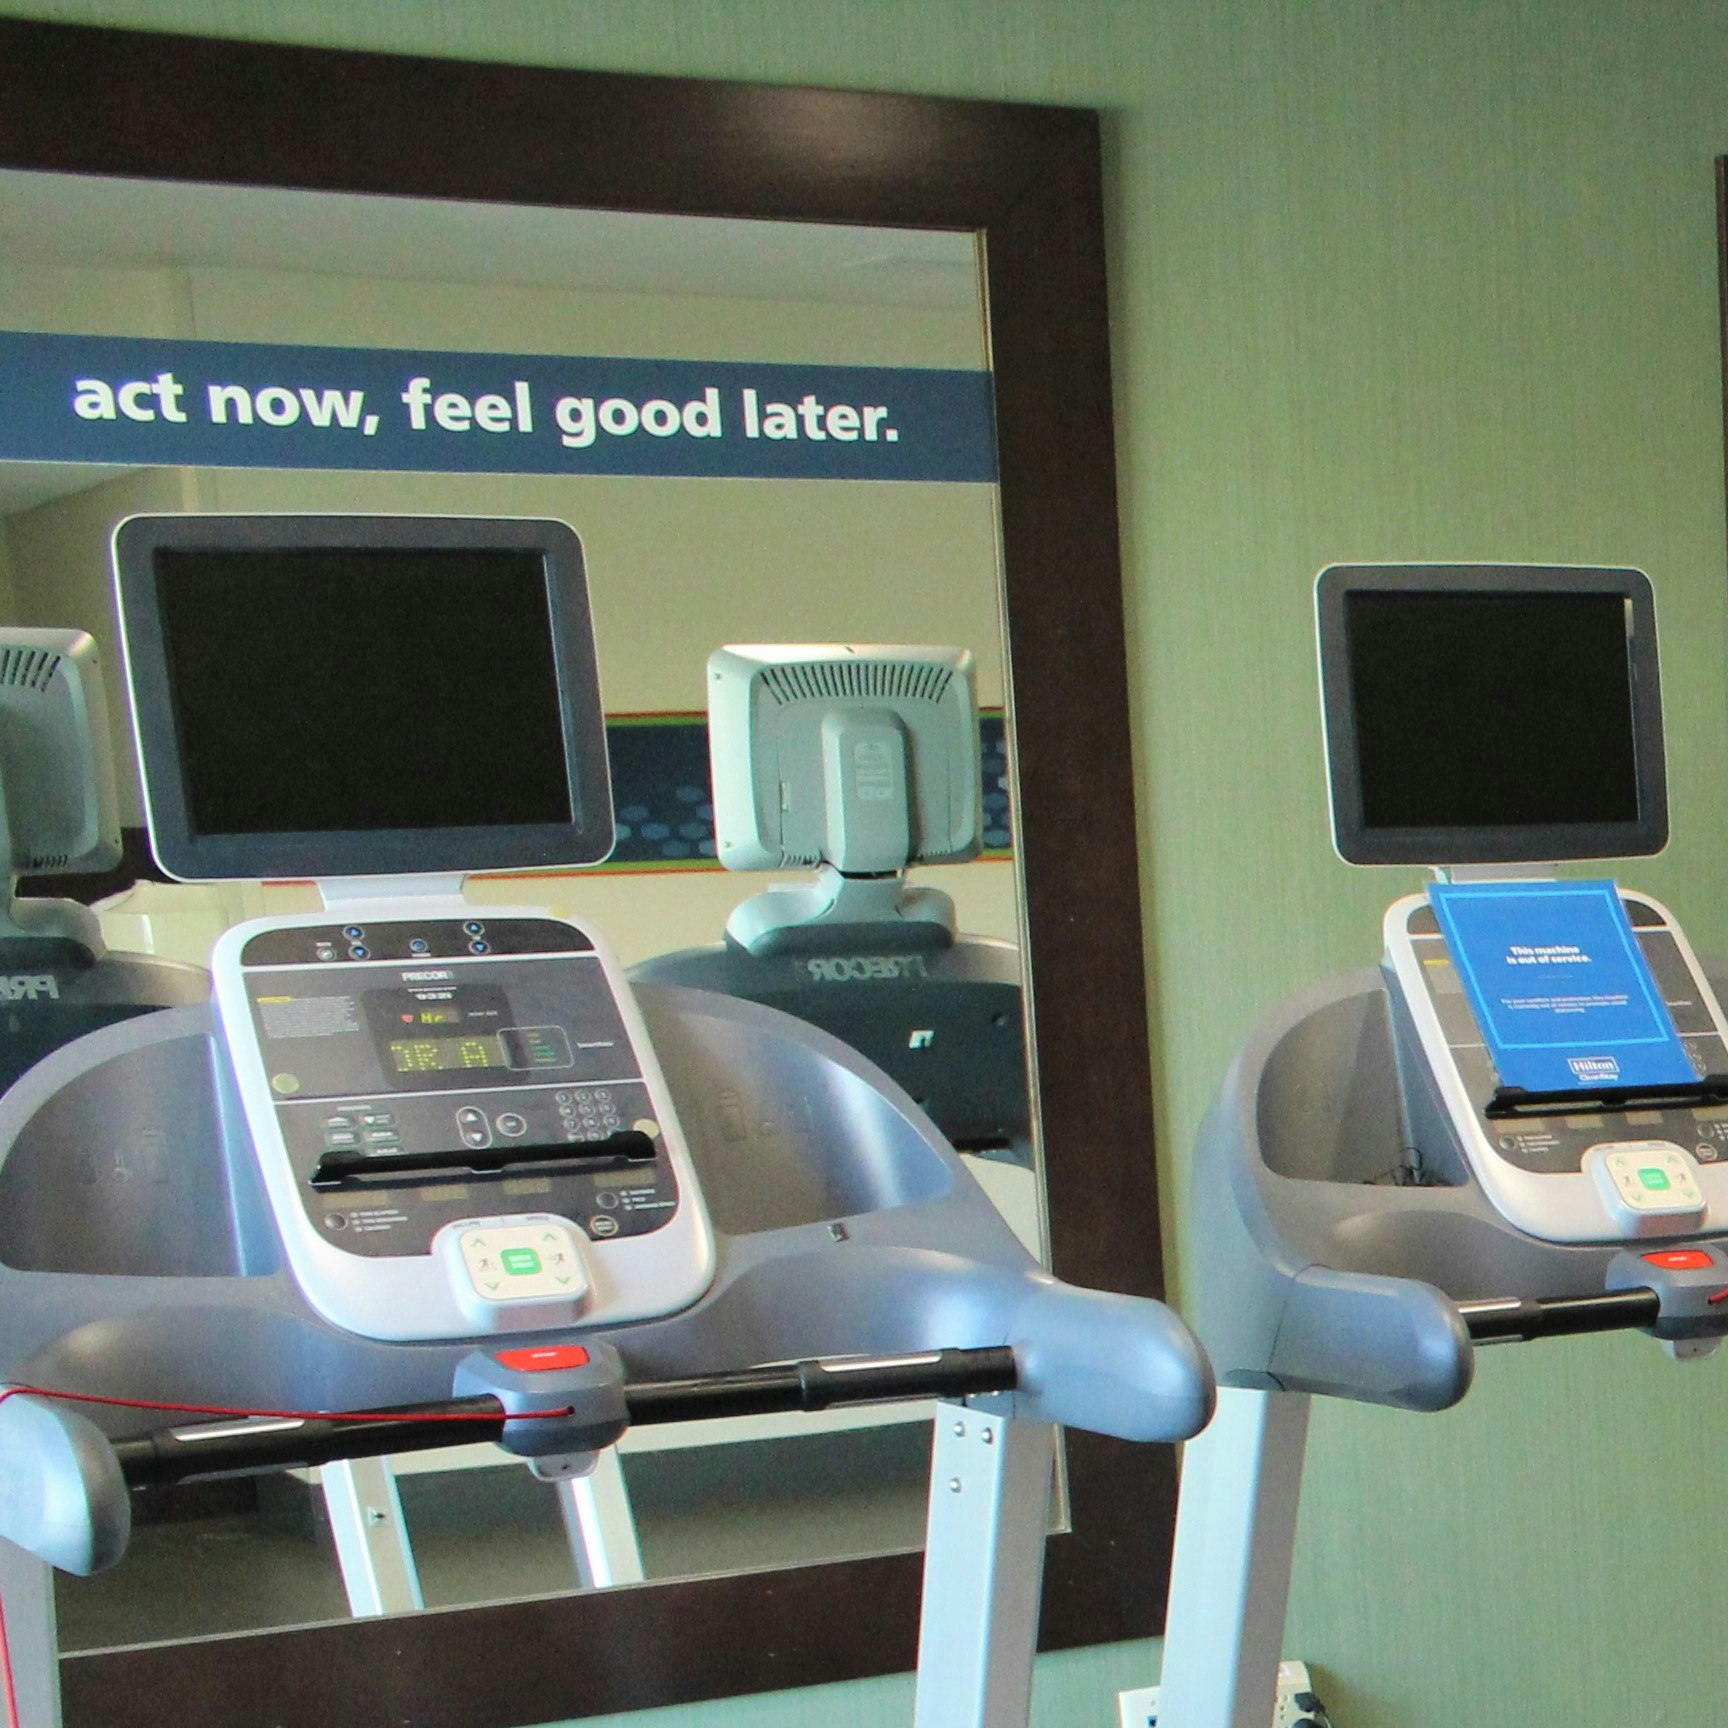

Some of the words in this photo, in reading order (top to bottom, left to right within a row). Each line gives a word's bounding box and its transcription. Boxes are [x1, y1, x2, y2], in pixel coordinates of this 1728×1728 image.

[73, 372, 187, 422] act
[207, 382, 379, 435] now,
[402, 376, 533, 434] feel
[555, 387, 723, 449] good
[742, 388, 899, 442] later.
[1510, 945, 1534, 955] This
[1535, 945, 1580, 955] machine
[1518, 956, 1537, 964] out
[1538, 955, 1550, 964] of
[1551, 955, 1592, 964] service.
[1573, 1060, 1615, 1072] Hilton
